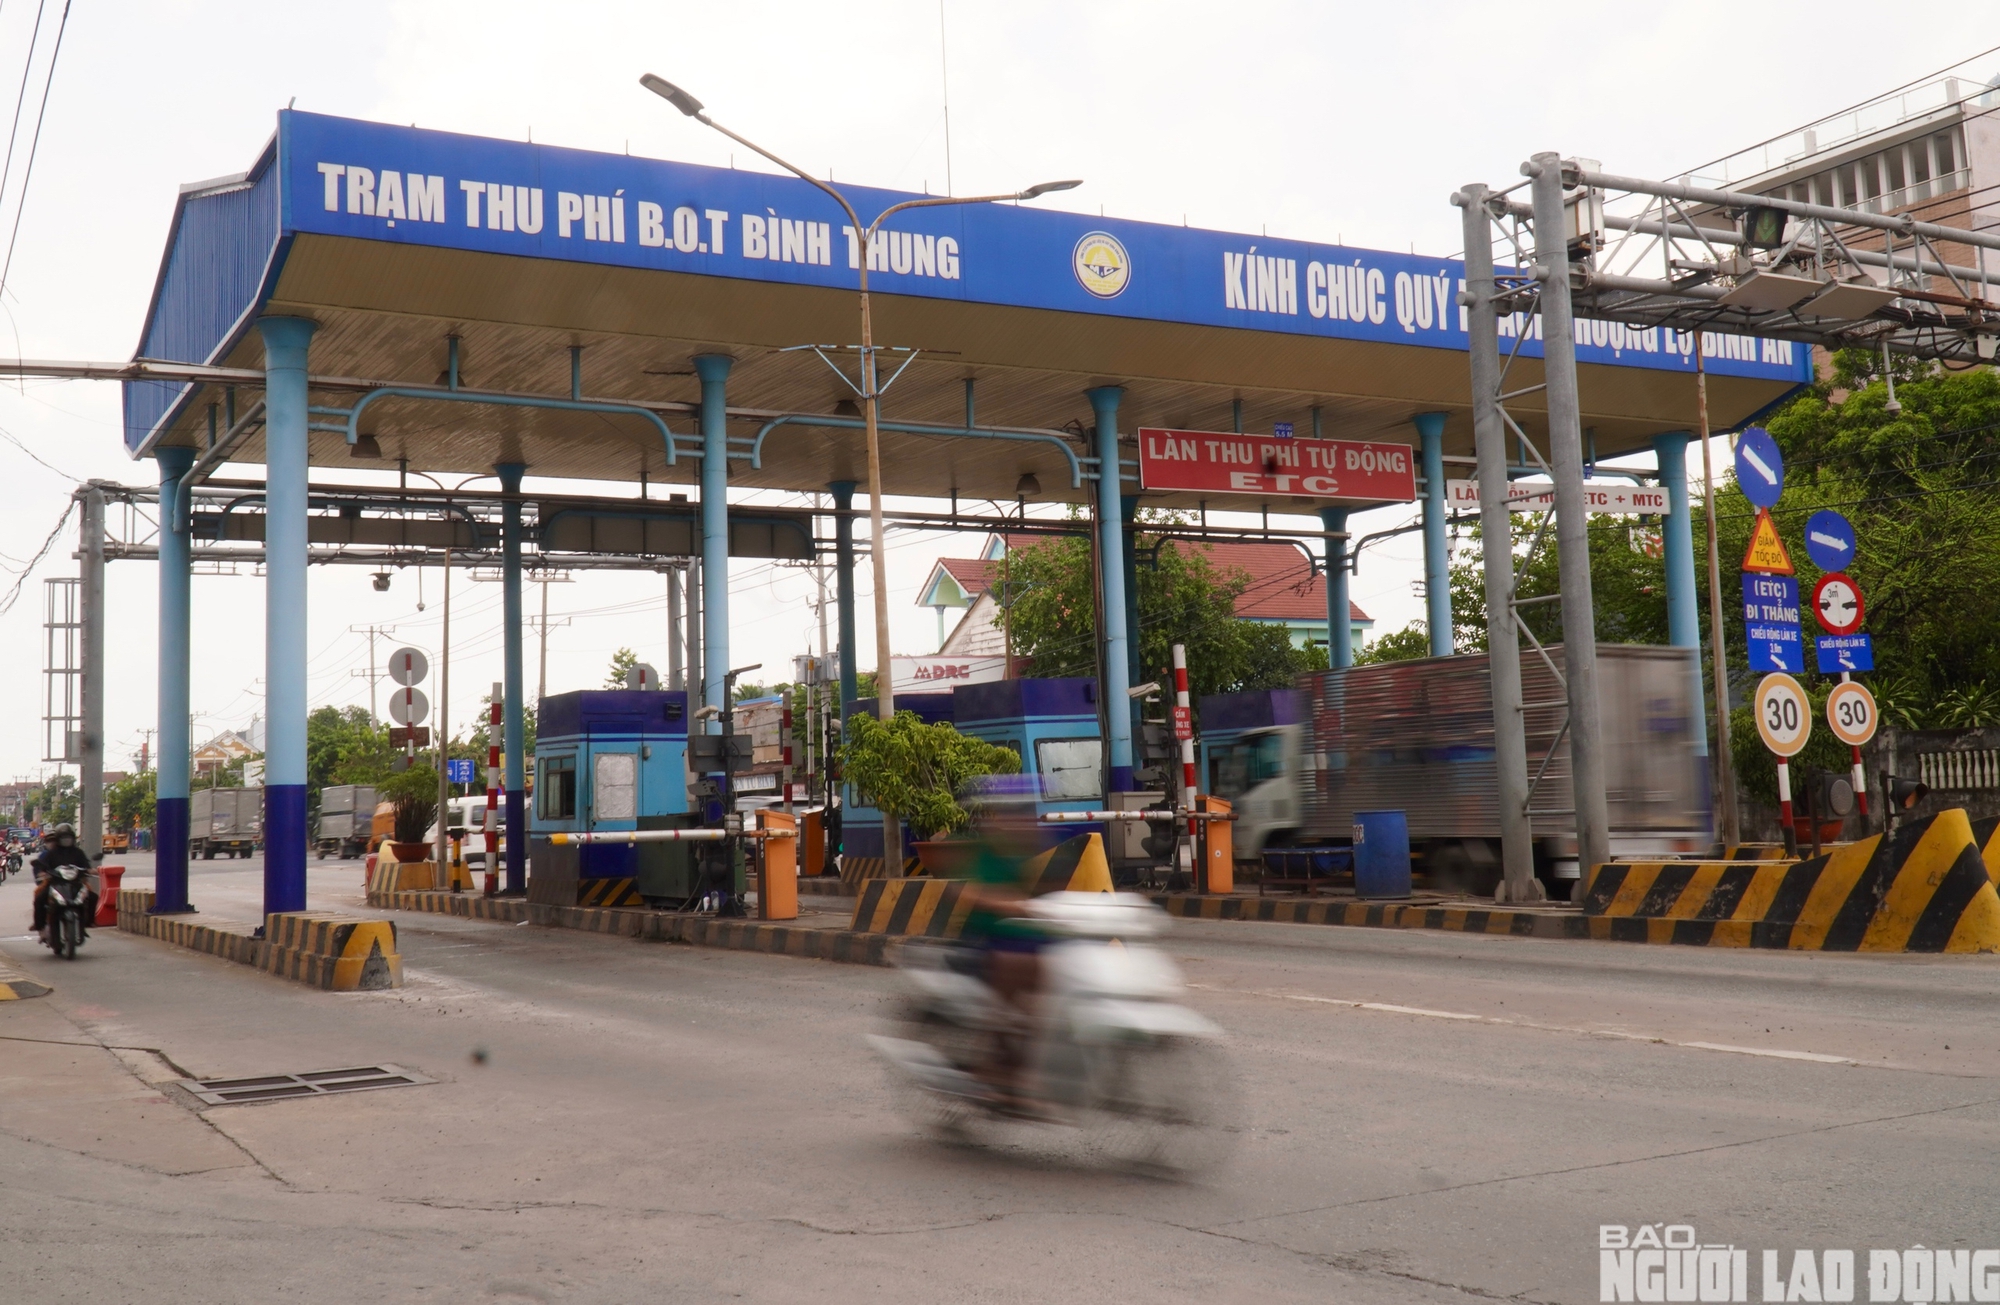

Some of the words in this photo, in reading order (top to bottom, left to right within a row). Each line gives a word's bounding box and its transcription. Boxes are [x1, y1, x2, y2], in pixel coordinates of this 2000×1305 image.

[316, 161, 446, 229] TRẠM
[459, 179, 544, 235] THU
[557, 188, 626, 244] PHÍ
[637, 200, 729, 255] B.O.T
[742, 207, 831, 267] BÌNH
[842, 225, 961, 280] THUNG
[1223, 245, 1298, 315] KÍNH
[1306, 258, 1387, 326] CHÚC
[1394, 269, 1450, 334] QUÝ
[1148, 432, 1198, 462] LÀN
[1204, 440, 1254, 465] THU
[1260, 441, 1300, 468] PHÍ
[1306, 445, 1338, 474] TỰ
[1345, 444, 1406, 476] ĐỘNG
[1230, 471, 1340, 494] ETC
[1455, 486, 1480, 501] LÀ
[1633, 493, 1663, 507] MTC
[1754, 579, 1787, 599] (ETC)
[1827, 588, 1839, 598] 3m
[1746, 603, 1759, 619] ĐI
[1790, 630, 1798, 641] XE
[1859, 638, 1866, 647] XE
[932, 664, 970, 679] DRC
[1767, 698, 1798, 731] 30
[1839, 699, 1867, 727] 30
